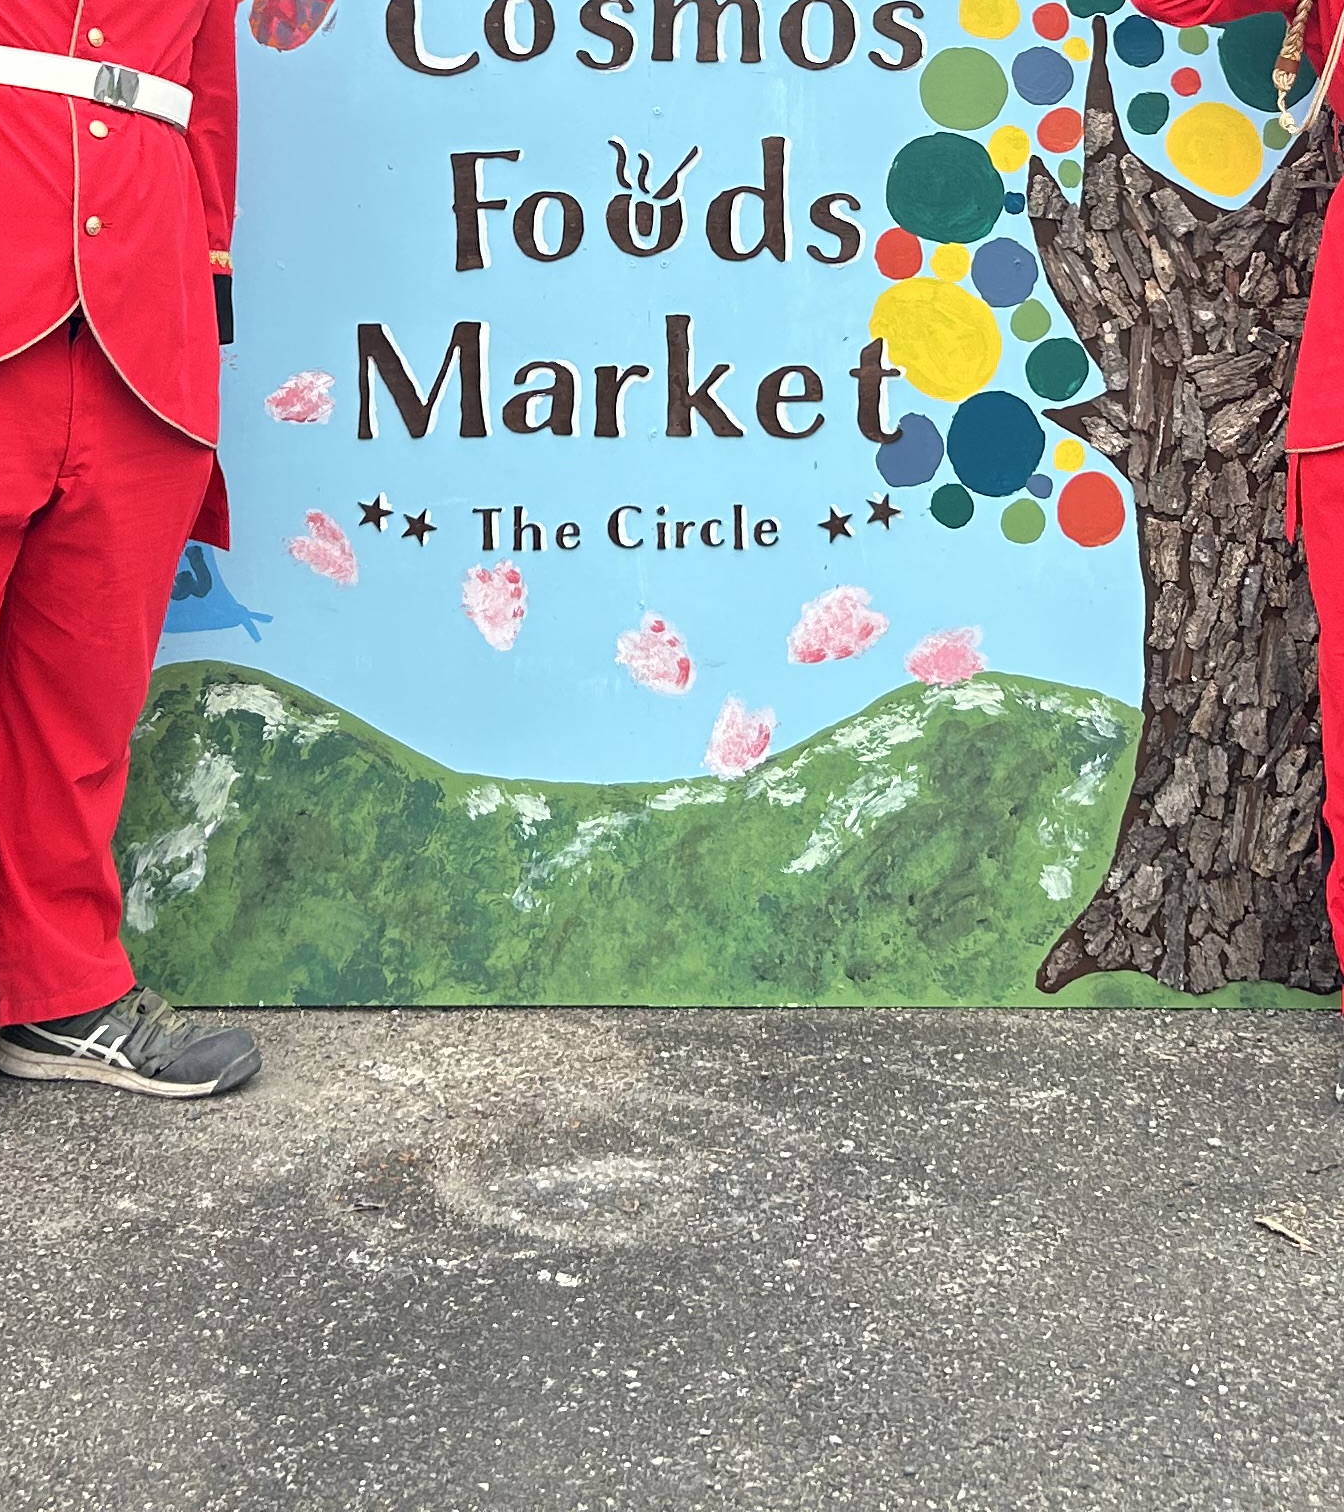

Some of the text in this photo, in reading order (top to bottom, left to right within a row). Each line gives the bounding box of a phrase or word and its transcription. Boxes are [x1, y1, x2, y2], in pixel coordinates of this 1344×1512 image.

[451, 137, 862, 272] Foods
[357, 314, 905, 445] Market
[472, 505, 780, 551] The Circle
